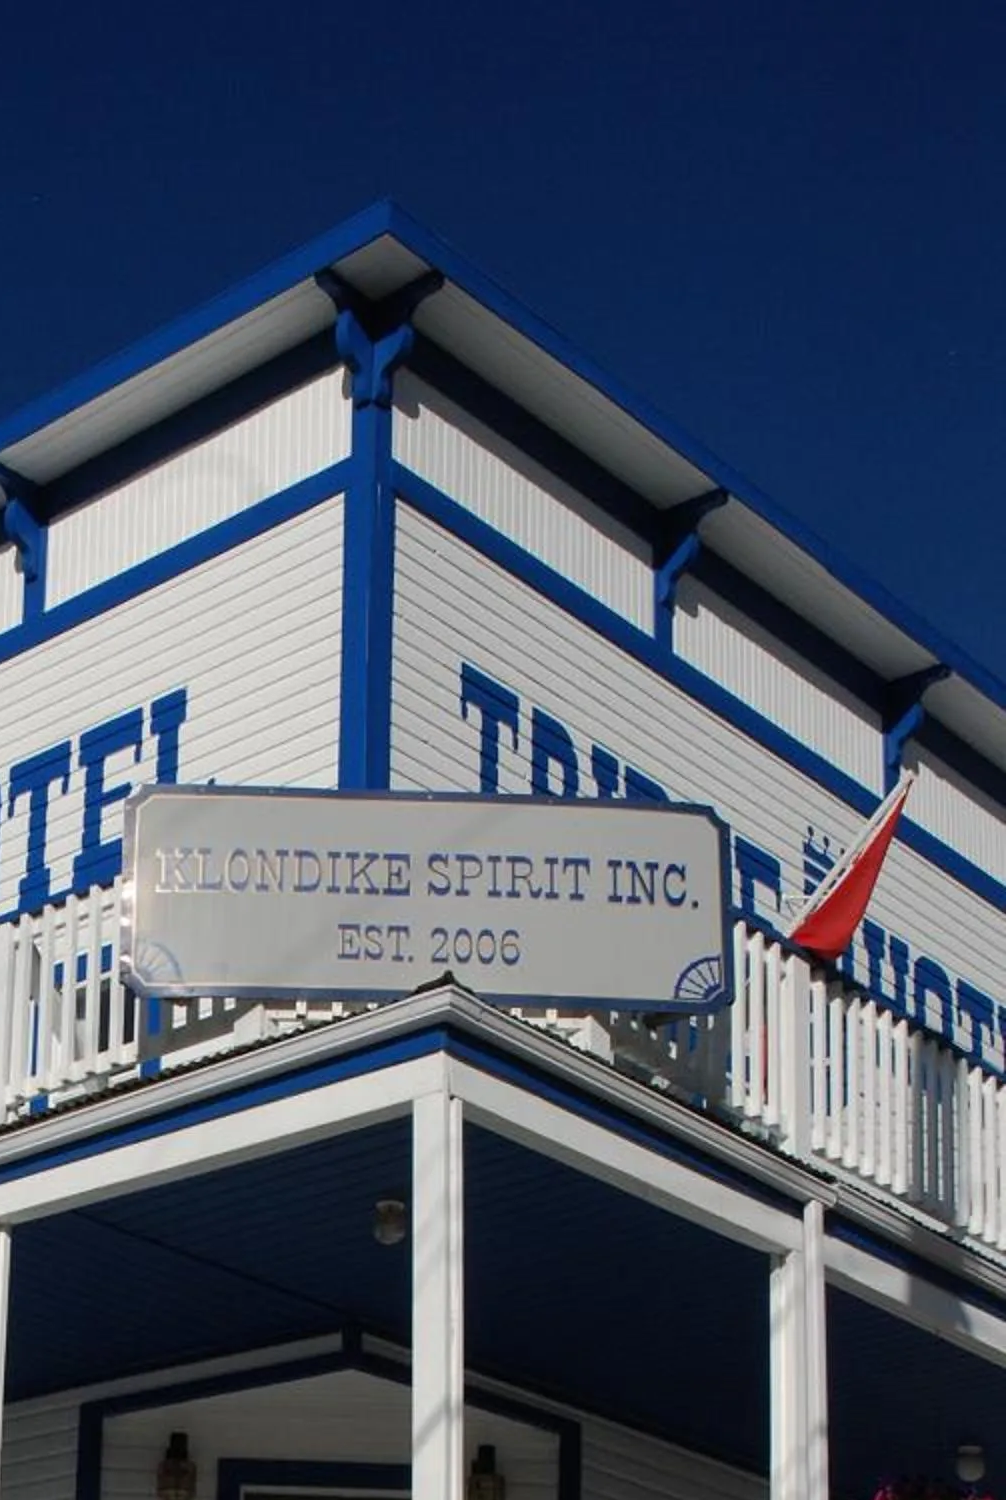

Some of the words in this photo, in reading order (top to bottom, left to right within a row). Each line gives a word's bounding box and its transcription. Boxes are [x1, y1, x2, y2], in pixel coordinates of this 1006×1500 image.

[155, 849, 410, 896] KLONDIKE
[426, 854, 591, 901] SPIRIT
[606, 860, 700, 908] INC.
[337, 924, 413, 963] EST.
[430, 928, 521, 965] 2006
